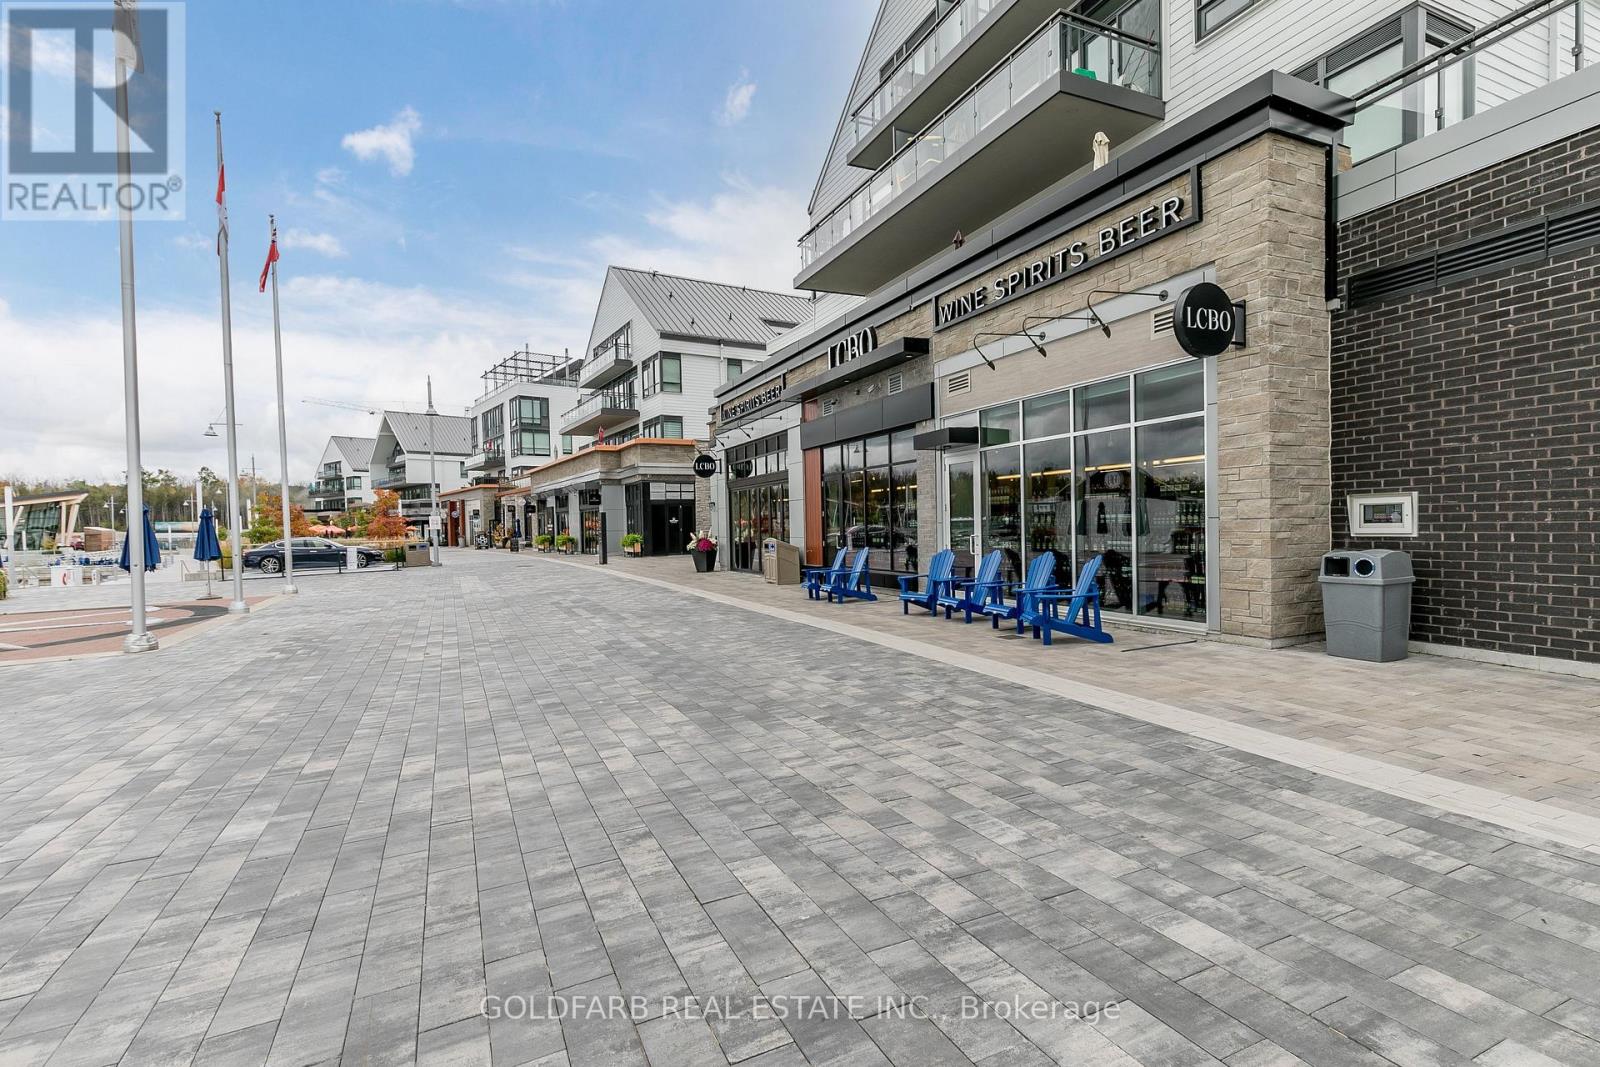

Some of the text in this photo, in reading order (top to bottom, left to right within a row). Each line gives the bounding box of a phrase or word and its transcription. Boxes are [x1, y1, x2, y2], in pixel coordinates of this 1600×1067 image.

[938, 195, 1185, 325] WINE SPIRITS BEER
[1186, 306, 1231, 333] LCBO
[828, 326, 875, 371] LCBO
[737, 395, 761, 414] SPIRITS
[762, 385, 782, 404] BEER
[695, 462, 715, 471] LCBO
